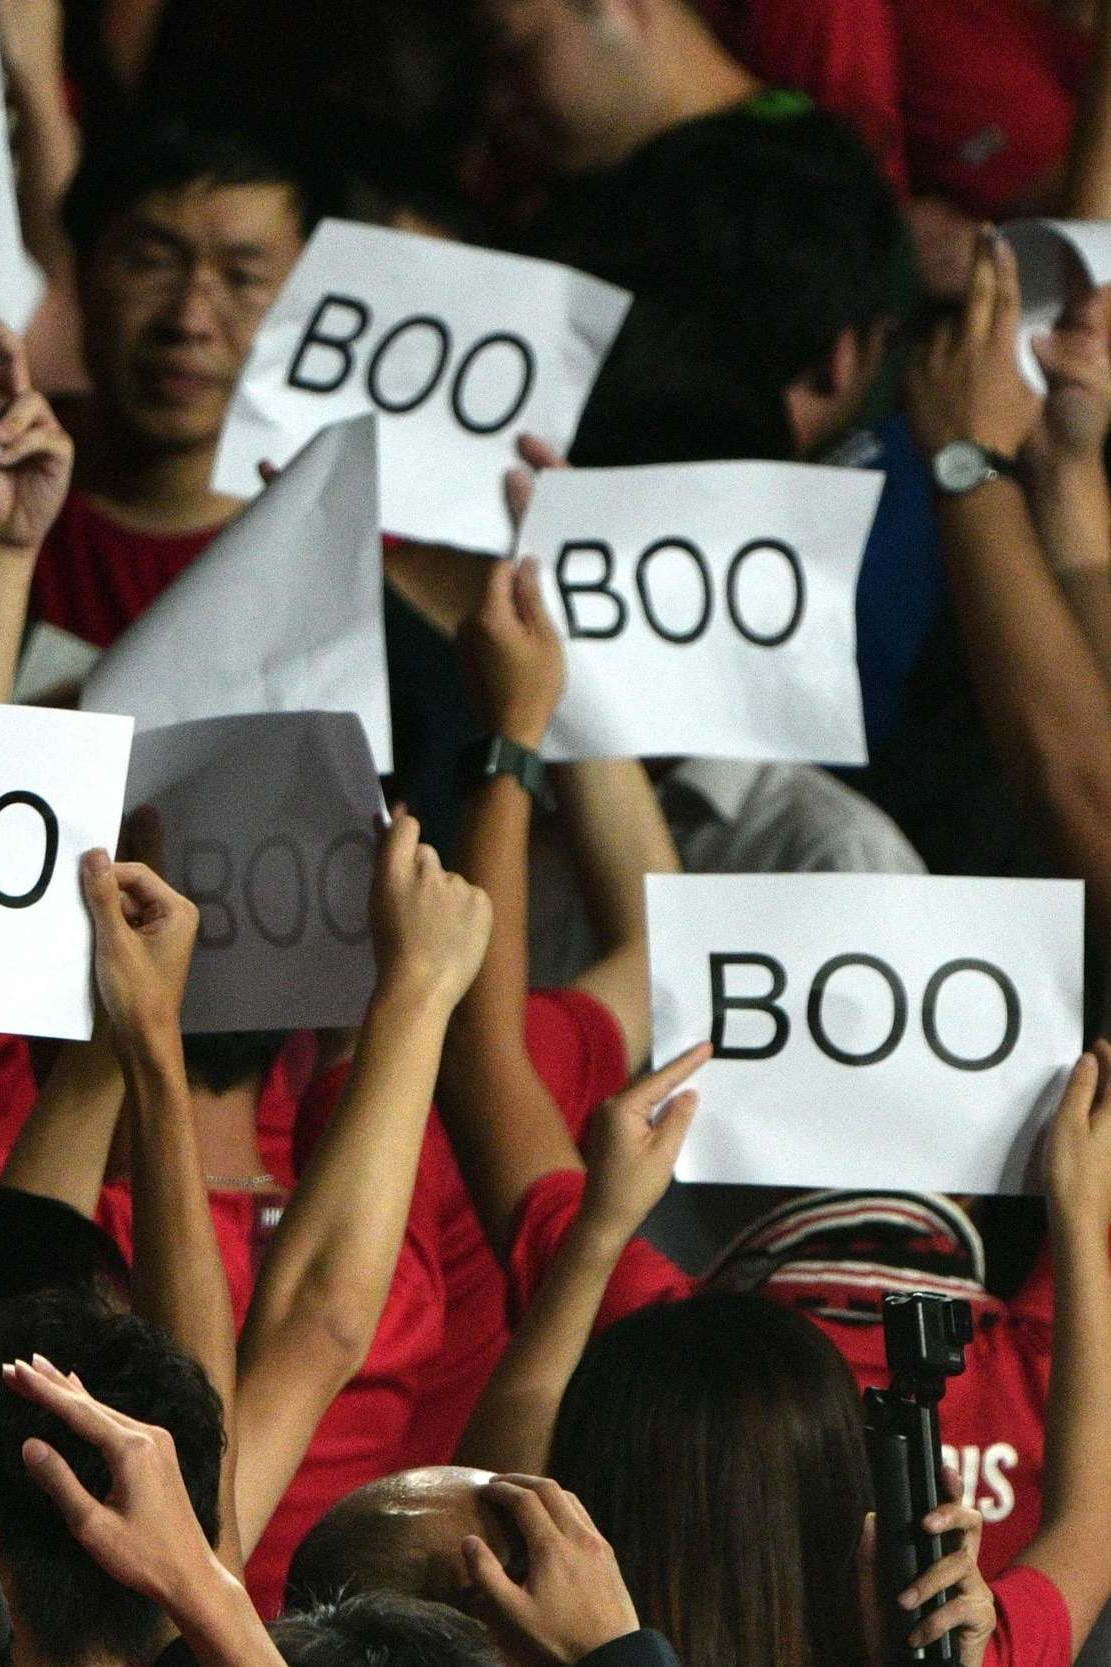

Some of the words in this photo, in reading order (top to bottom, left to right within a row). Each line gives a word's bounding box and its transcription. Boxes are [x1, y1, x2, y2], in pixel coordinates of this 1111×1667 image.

[286, 292, 536, 436] BOO
[555, 536, 805, 648] BOO
[183, 832, 377, 948] BOO
[708, 951, 1023, 1072] BOO
